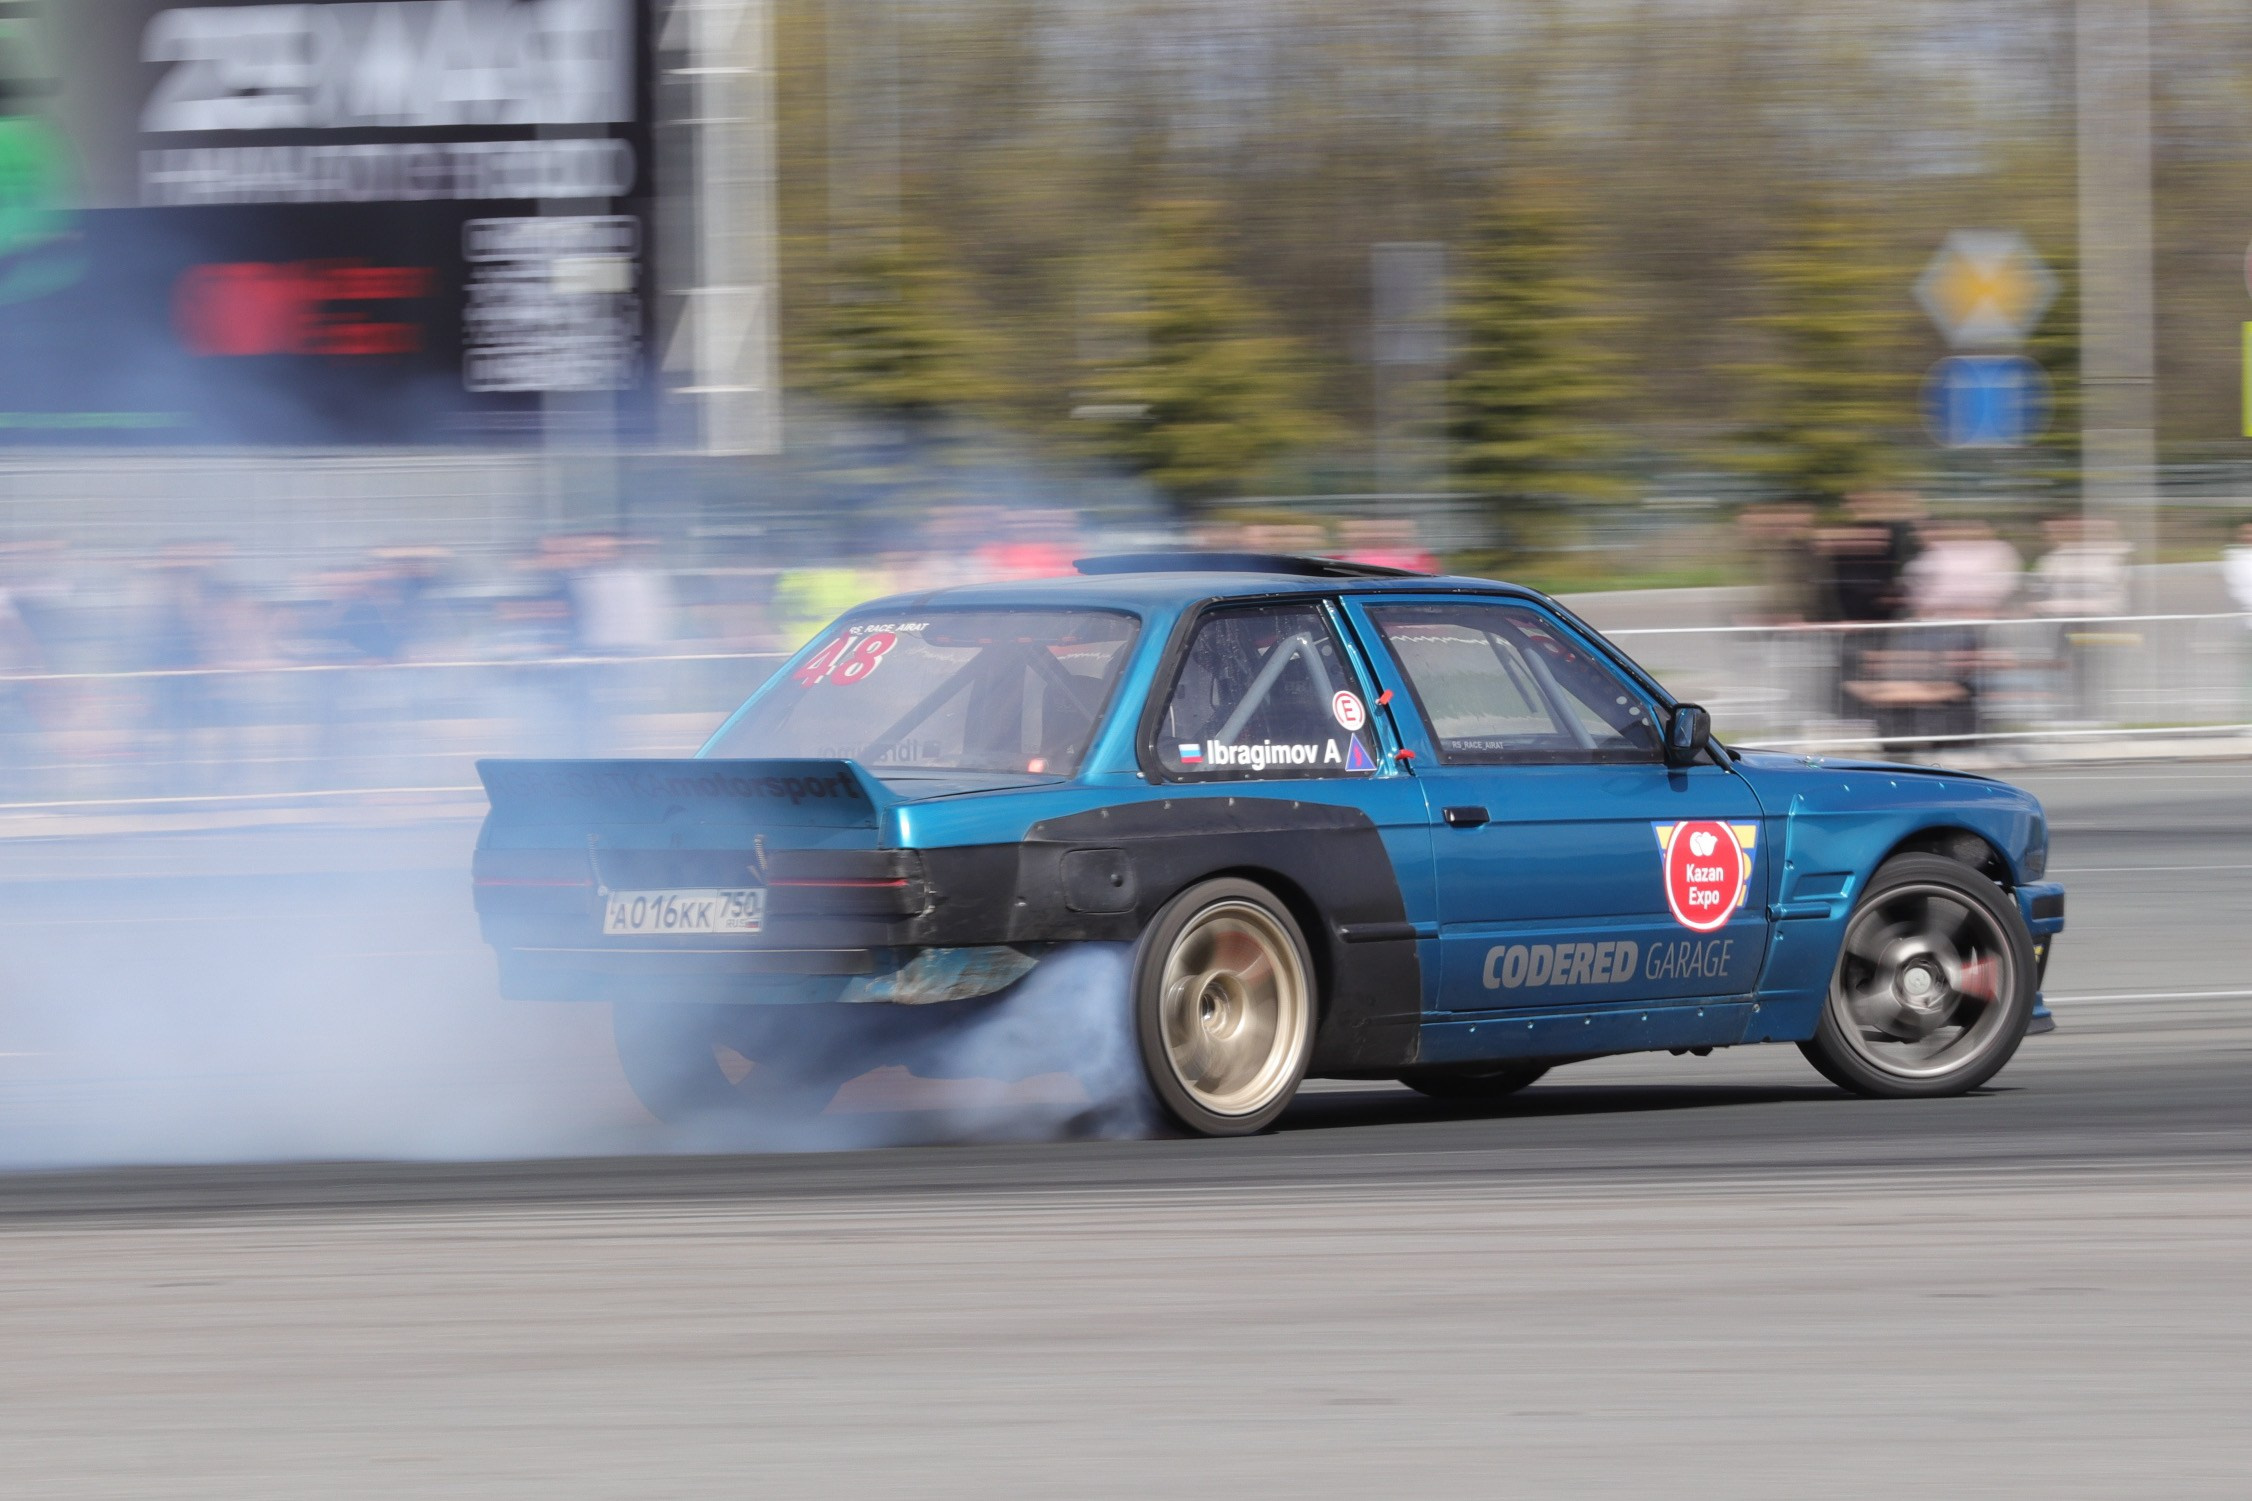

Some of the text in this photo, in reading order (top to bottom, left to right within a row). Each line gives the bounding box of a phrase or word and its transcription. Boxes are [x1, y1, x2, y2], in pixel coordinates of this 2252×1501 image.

[792, 631, 899, 689] 48
[1206, 738, 1342, 771] Ibragimov A
[1685, 863, 1725, 883] Kazan
[719, 891, 759, 918] 750
[1688, 886, 1721, 911] Expo
[1482, 939, 1734, 989] CODERED GARAGE
